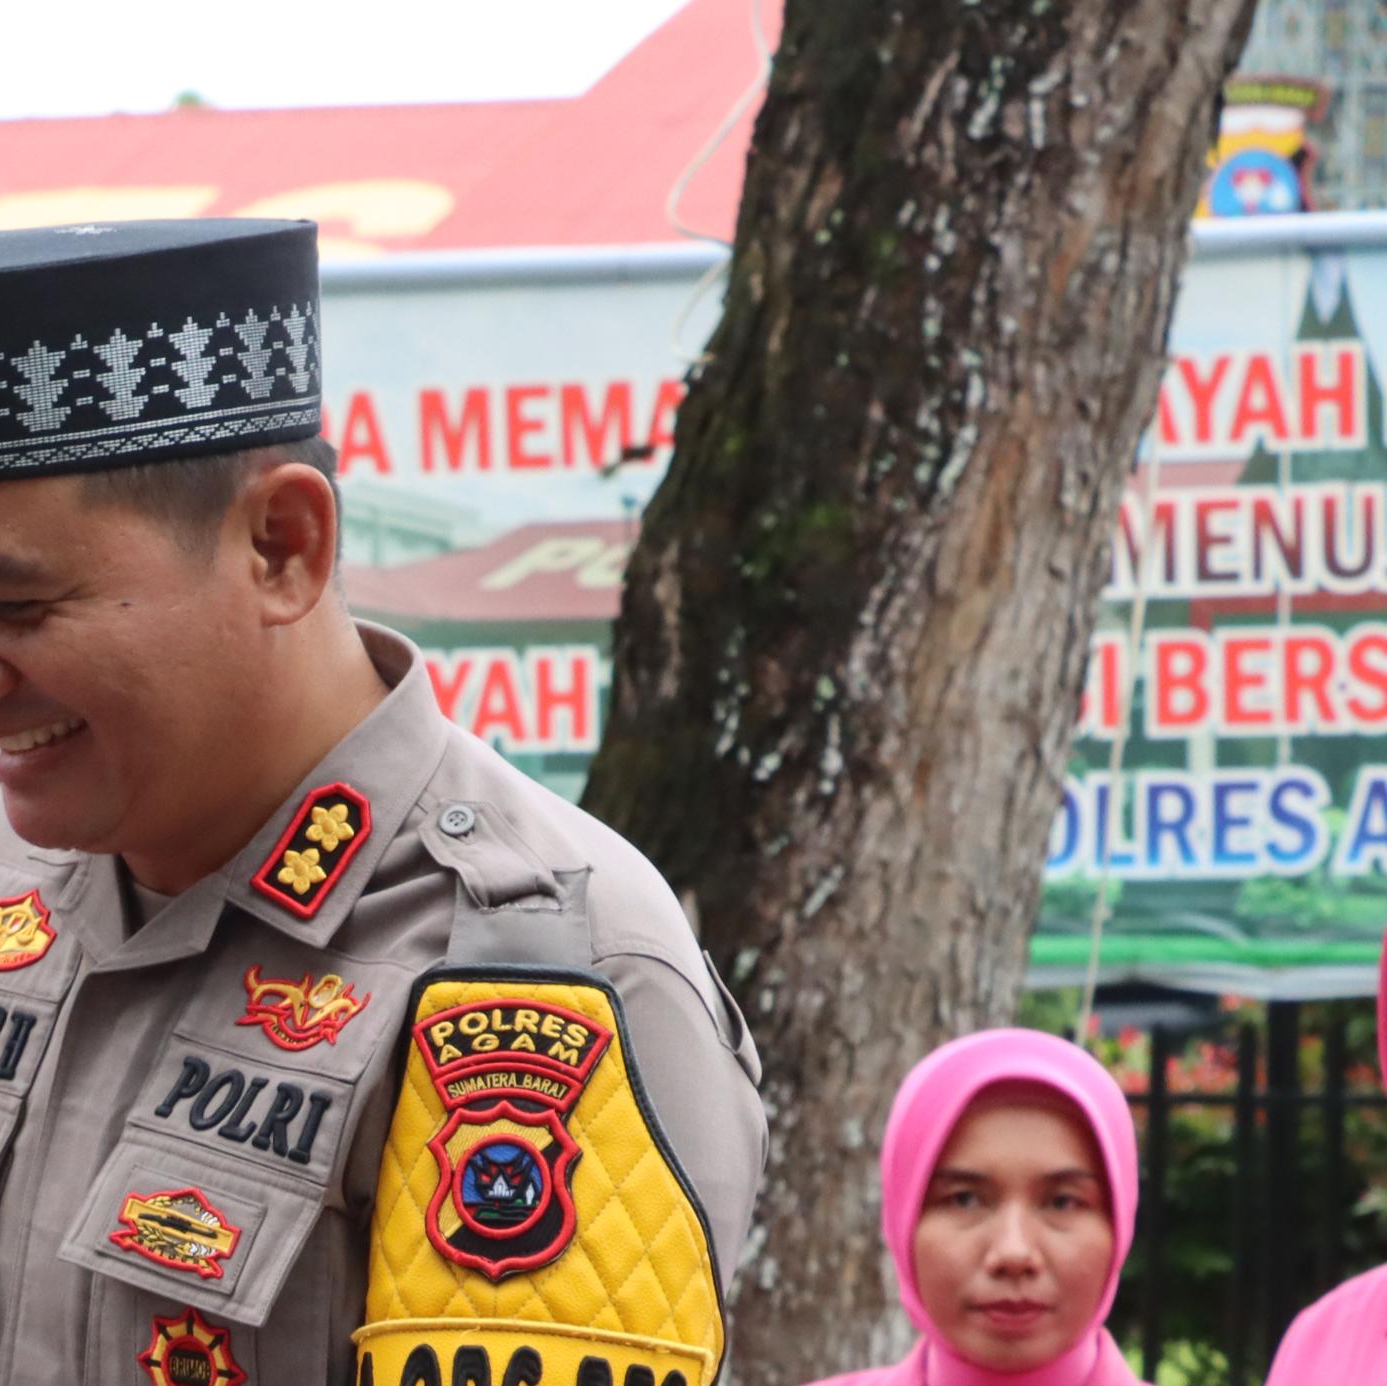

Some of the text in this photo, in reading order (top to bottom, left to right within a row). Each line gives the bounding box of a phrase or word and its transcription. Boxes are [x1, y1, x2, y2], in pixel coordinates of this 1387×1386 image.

[430, 1008, 589, 1048] POLRES
[439, 1033, 579, 1066] AGAM
[448, 1072, 568, 1101] SUMATERA BARAT
[154, 1055, 333, 1165] POLRI
